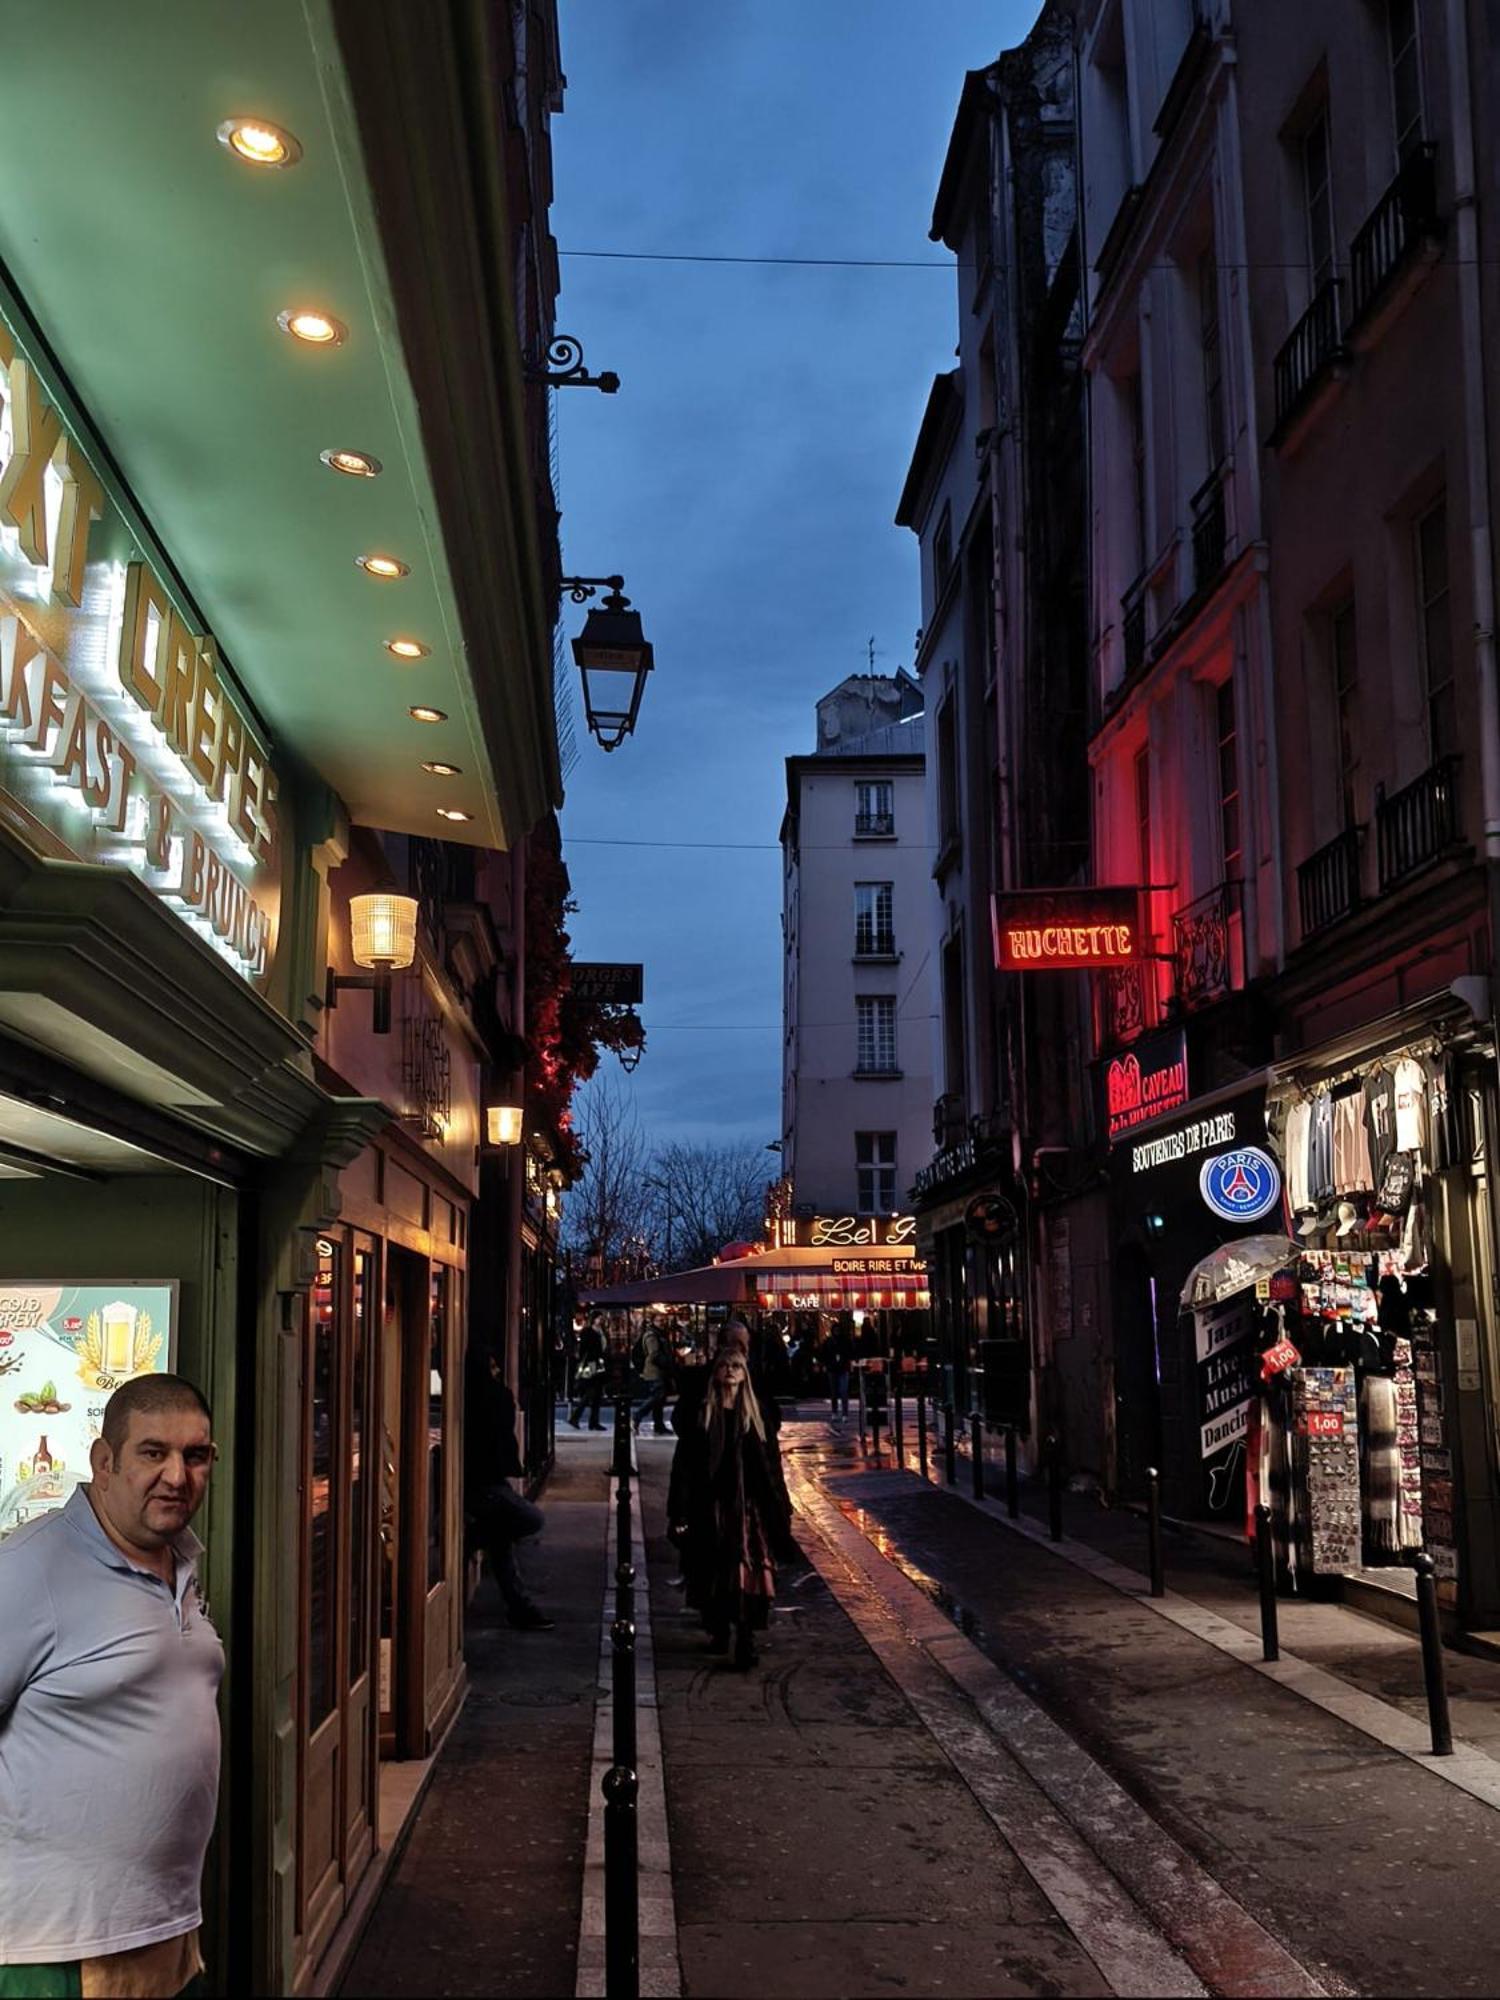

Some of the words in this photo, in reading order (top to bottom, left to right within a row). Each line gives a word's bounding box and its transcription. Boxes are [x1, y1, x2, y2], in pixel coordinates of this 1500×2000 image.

[180, 828, 271, 976] BRUNCH
[1008, 925, 1132, 959] HUCHETTE
[1142, 1062, 1183, 1102] CAVEAU
[1133, 1131, 1185, 1173] SOUVENIRS
[1185, 1124, 1201, 1154] DE
[1201, 1112, 1236, 1149] PARIS
[1218, 1154, 1261, 1170] PARIS
[834, 1261, 866, 1272] BOIRE
[868, 1260, 892, 1271] RIRE
[895, 1260, 907, 1270] ET
[0, 1297, 41, 1313] COLD
[1207, 1354, 1239, 1387] Live
[1270, 1348, 1295, 1367] 1,00
[1314, 1416, 1339, 1431] 1,00
